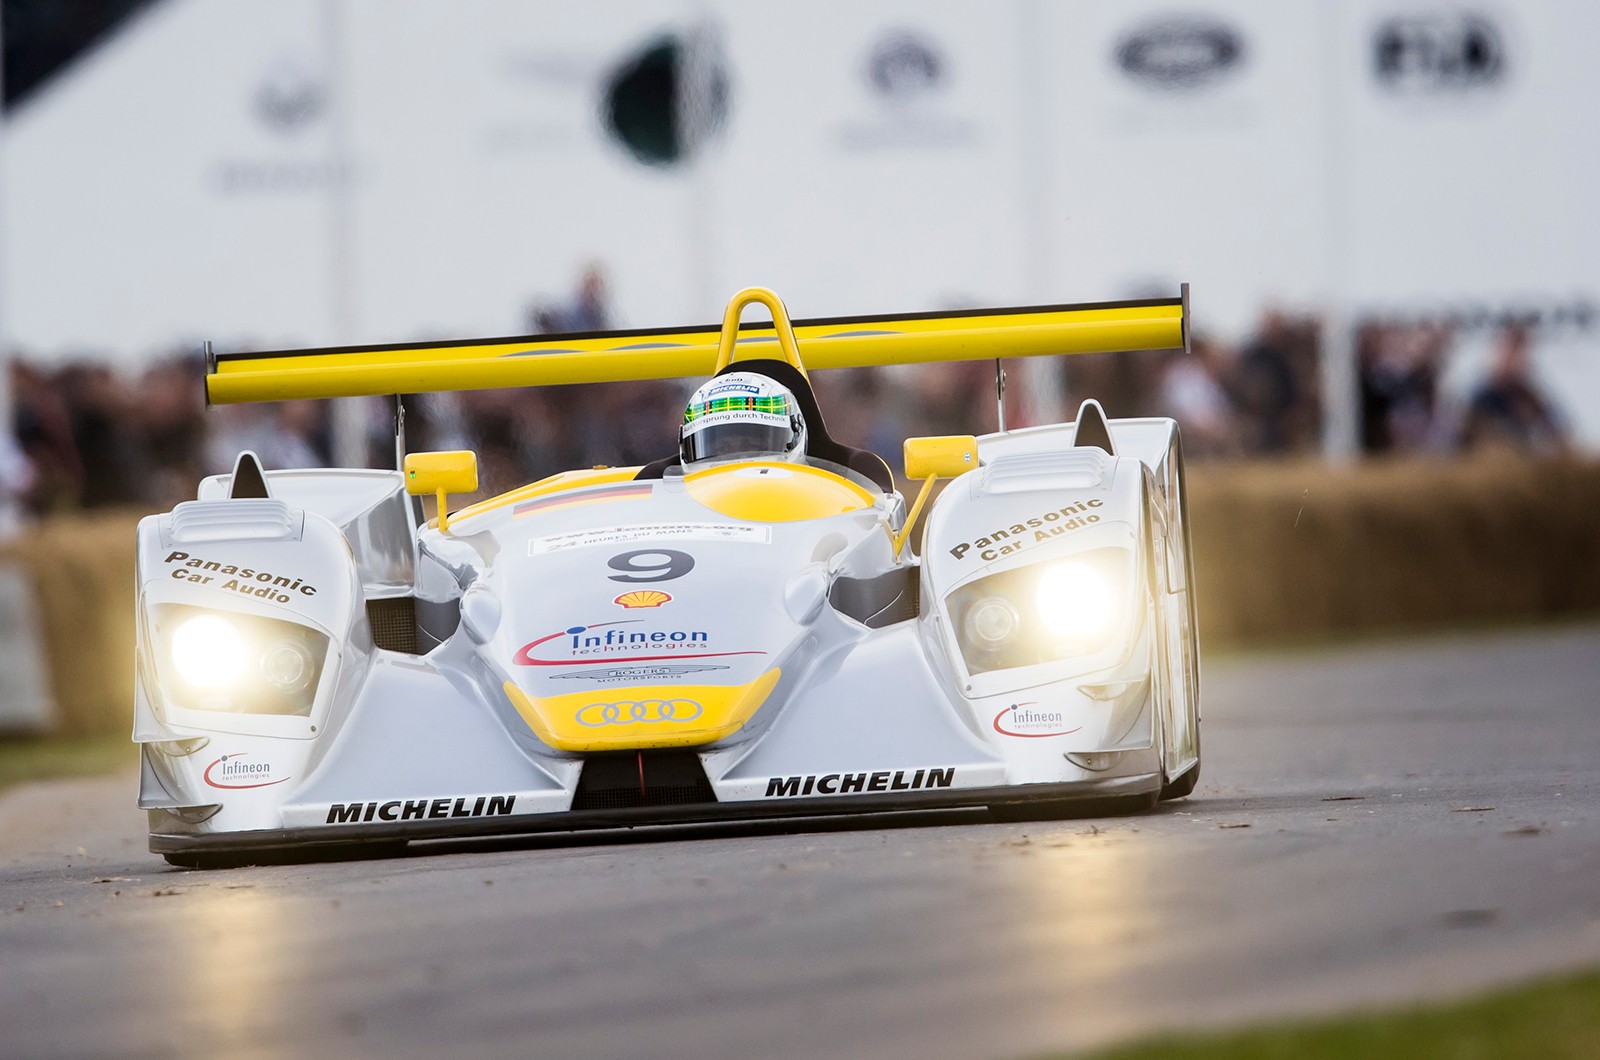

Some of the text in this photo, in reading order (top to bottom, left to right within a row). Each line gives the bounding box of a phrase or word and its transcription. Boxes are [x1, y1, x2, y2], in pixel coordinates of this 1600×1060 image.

[710, 384, 758, 394] MICHELIN
[759, 412, 787, 423] Technik
[583, 533, 629, 545] HEURES
[633, 531, 651, 539] DU
[655, 528, 693, 536] MANS
[949, 498, 1104, 560] Panasonic
[980, 514, 1101, 561] Car Audio
[164, 550, 318, 597] Panasonic
[607, 549, 696, 583] 9
[171, 568, 291, 605] Car Audio
[571, 642, 708, 657] technologies
[596, 674, 683, 684] MOTORSPORTS
[612, 668, 670, 677] ROGERS
[222, 772, 271, 780] technologies
[764, 767, 956, 798] MICHELIN
[325, 794, 517, 824] MICHELIN
